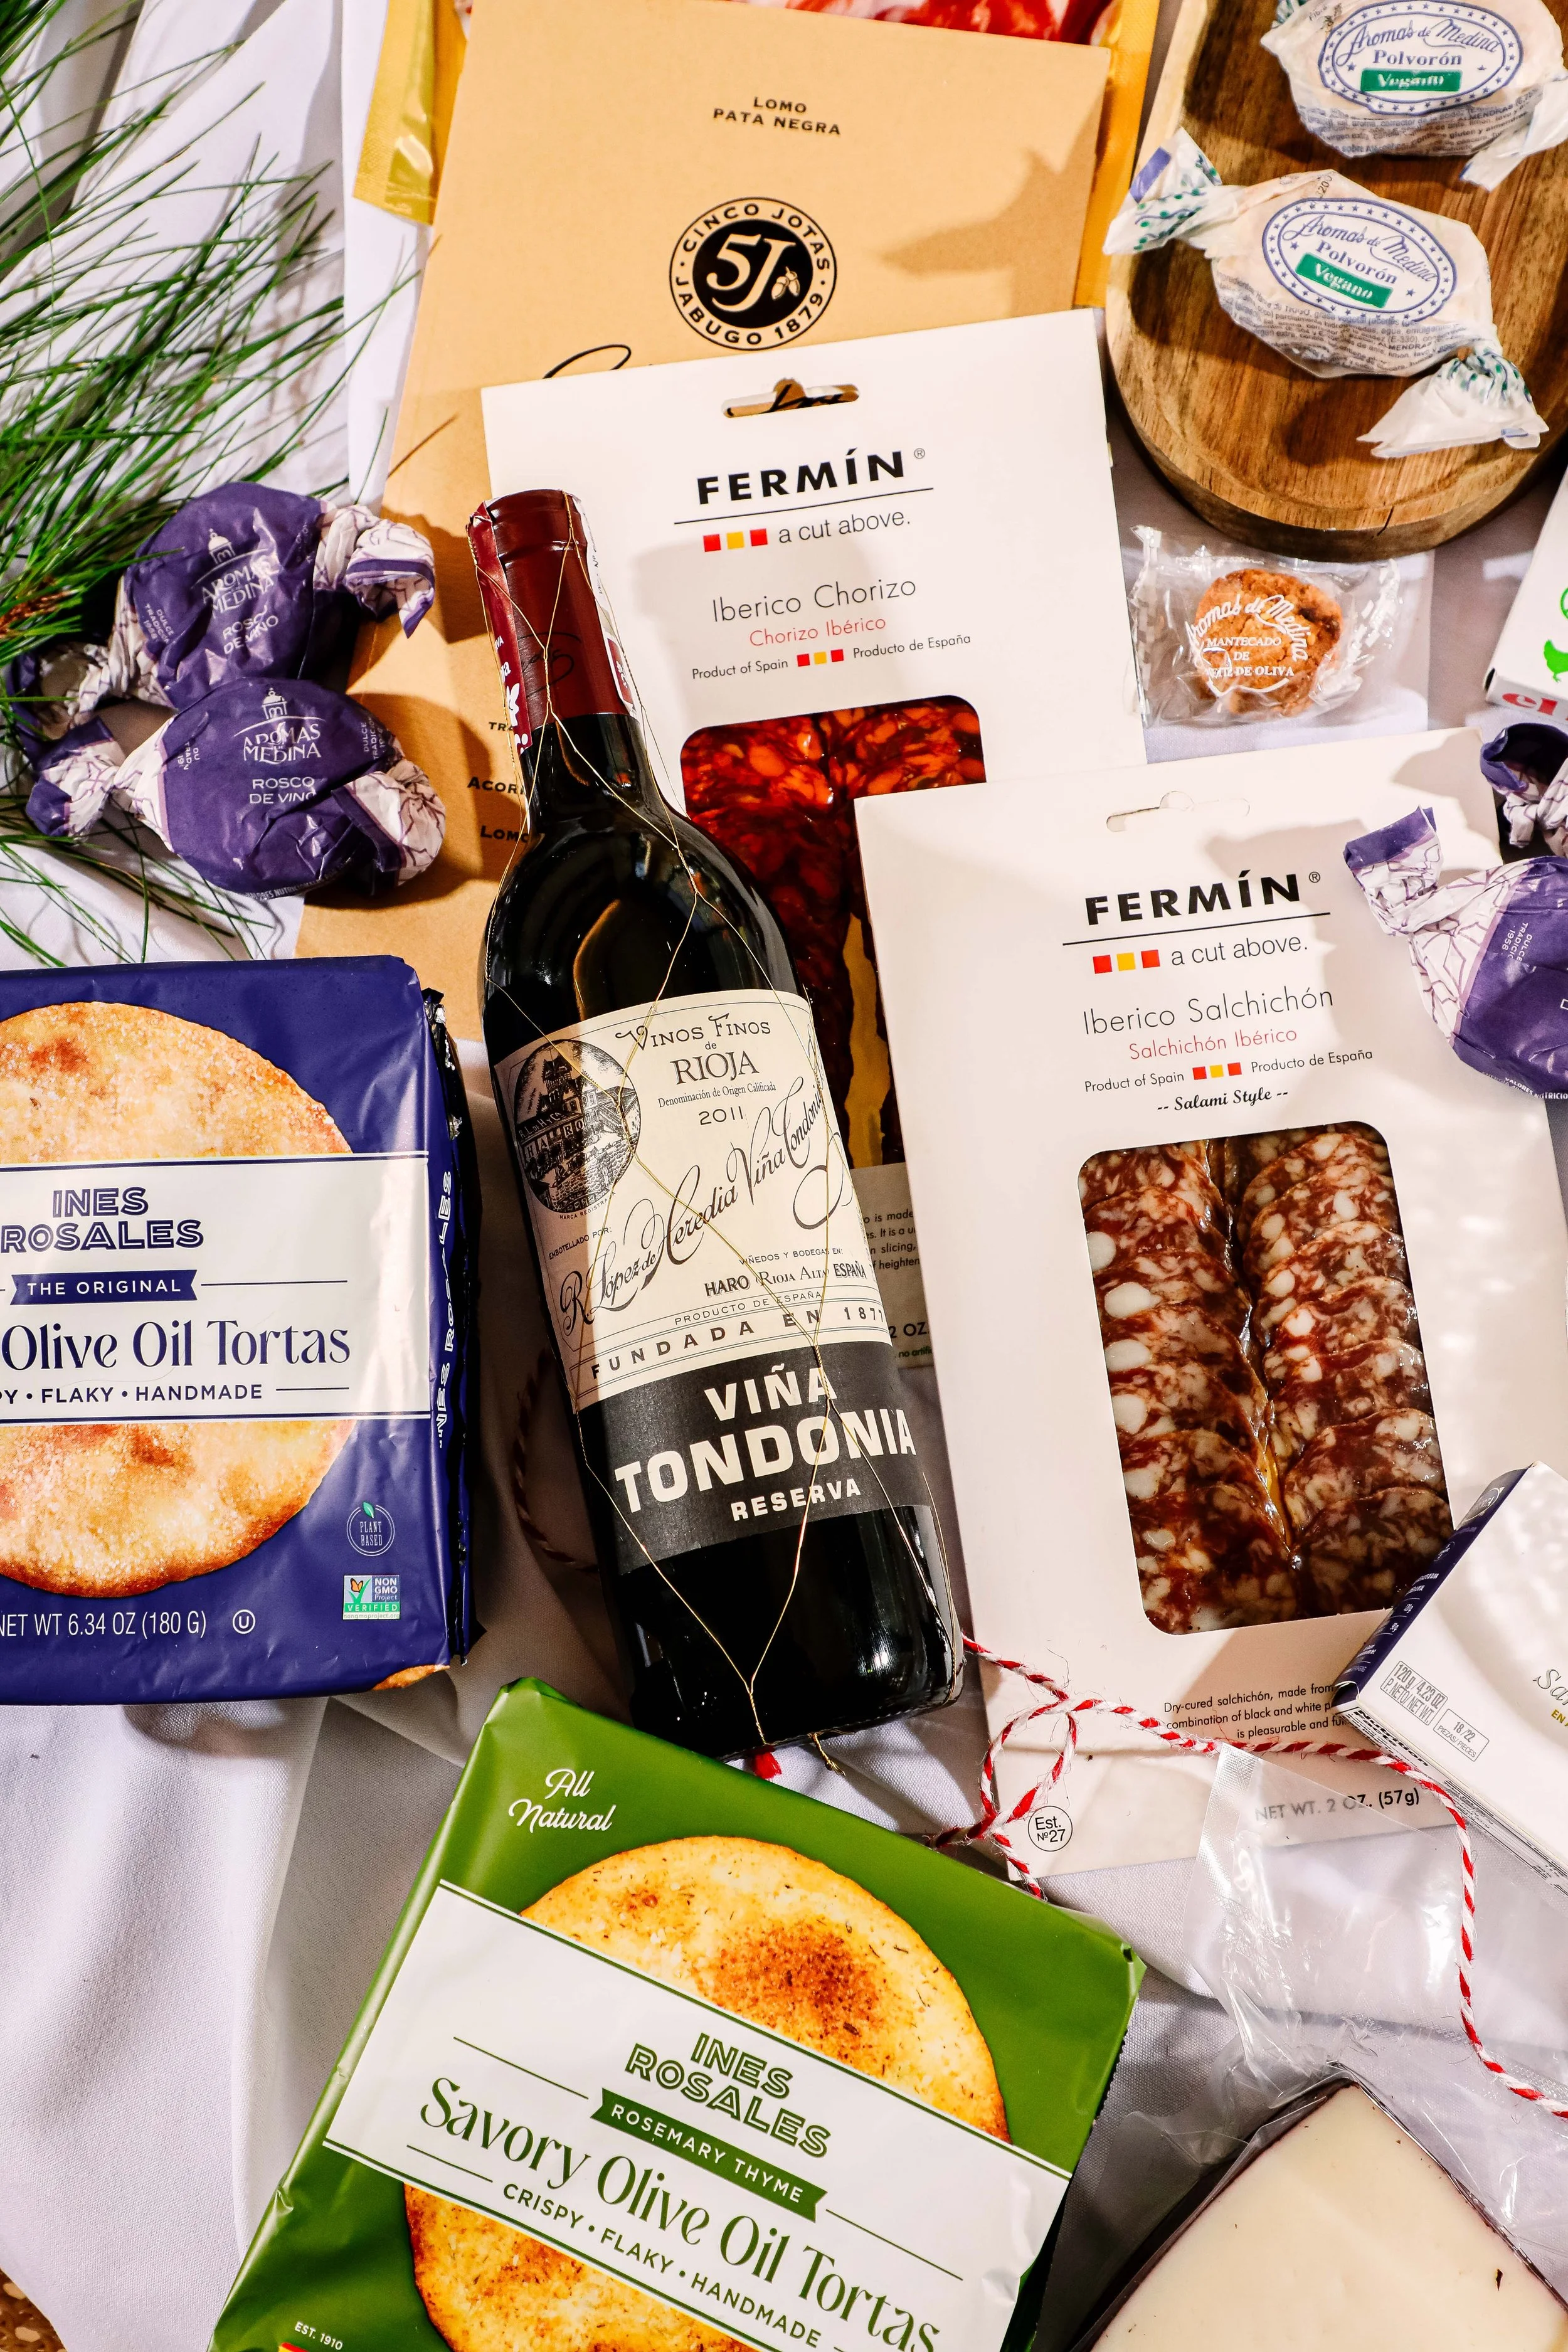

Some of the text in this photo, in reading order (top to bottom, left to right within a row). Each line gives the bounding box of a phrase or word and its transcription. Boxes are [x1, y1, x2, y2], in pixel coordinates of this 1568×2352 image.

[1337, 19, 1501, 67] Aromas de Medina
[1372, 49, 1462, 66] Polvorón
[753, 96, 807, 114] LOMO
[713, 108, 842, 136] PATA NEGRA
[682, 203, 831, 271] CINCO JOTAS
[1282, 215, 1438, 282] Aromas de Medina
[706, 233, 797, 314] 5J
[1317, 240, 1397, 285] Polvorón
[1313, 263, 1373, 300] Vegano
[675, 276, 824, 346] JABUGO 1879
[697, 447, 904, 506] FERMÍN
[779, 511, 911, 544] a cut above.
[712, 579, 916, 623] Iberico Chorizo
[223, 637, 245, 655] DE
[750, 617, 886, 647] Chorizo Ibérico
[1207, 637, 1282, 647] MANTECADO
[692, 633, 972, 680] Product of Spain Producto de España
[1234, 651, 1250, 661] DE
[1236, 667, 1253, 677] DE
[1255, 667, 1295, 677] OLIVA
[361, 722, 369, 752] DULCE
[243, 743, 322, 765] MEDINA
[252, 776, 315, 790] ROSCO
[249, 793, 274, 805] DE
[1084, 869, 1300, 926] FERMÍN
[1170, 935, 1308, 966] a cut above.
[1502, 929, 1516, 951] 1958
[1517, 933, 1533, 962] DULCE
[1083, 985, 1334, 1035] Iberico Salchichón
[704, 1042, 717, 1050] de
[1129, 1029, 1298, 1061] Salchichón Ibérico
[670, 1049, 760, 1084] RIOJA
[1084, 1049, 1373, 1092] Product of Spain Producto de España
[657, 1081, 776, 1108] Denominación de Origen Calificada
[1174, 1086, 1272, 1111] Salami Style
[699, 1105, 744, 1126] 2011
[52, 1187, 149, 1218] INES
[874, 1212, 882, 1222] is
[0, 1219, 204, 1254] ROSALES
[549, 1227, 612, 1260] EMBOTELLADO POR:
[888, 1226, 905, 1237] is a
[641, 1253, 657, 1271] de
[832, 1247, 843, 1255] EN:
[881, 1242, 917, 1256] slicing,
[27, 1278, 181, 1296] THE ORIGINAL
[704, 1259, 867, 1297] HARO ESPAÑA
[674, 1289, 823, 1326] PRODUCTO DE ESPAÑA
[2, 1319, 351, 1371] Olive Oil Tortas
[591, 1308, 822, 1380] FUNDADA EN
[41, 1383, 263, 1404] FLAKY HANDMADE
[704, 1363, 838, 1422] VIÑA
[615, 1407, 917, 1513] TONDONIA
[730, 1477, 862, 1522] RESERVA
[359, 1520, 382, 1533] PLANT
[361, 1534, 383, 1546] BASED
[374, 1577, 397, 1586] NON
[347, 1603, 398, 1611] VERIFIED
[374, 1594, 398, 1602] Project
[34, 1610, 207, 1640] WT 6.34 OZ (180 G)
[1394, 1664, 1412, 1683] 120
[1164, 1683, 1335, 1714] Dry-cured salchichón, made from
[1166, 1700, 1322, 1730] combination of black and white
[1237, 1717, 1329, 1740] is pleasurable and
[1453, 1720, 1463, 1734] 18
[1550, 1708, 1565, 1724] EN
[1437, 1725, 1477, 1759] PIEZAS/ PIECES
[544, 1768, 595, 1799] All
[508, 1798, 617, 1833] Natural
[1254, 1803, 1285, 1821] NET
[1327, 1798, 1337, 1813] 2
[1343, 1793, 1373, 1810] OZ.
[1379, 1787, 1420, 1809] (57g)
[1035, 1816, 1062, 1830] Est.
[690, 2032, 794, 2099] INES
[624, 2043, 832, 2158] ROSALES
[611, 2103, 803, 2203] ROSEMARY THYME
[420, 2077, 941, 2352] Savory Olive Oil Tortas
[502, 2183, 822, 2348] CRISPY FLAKY HANDMADE
[294, 2321, 344, 2351] EST. 1910
